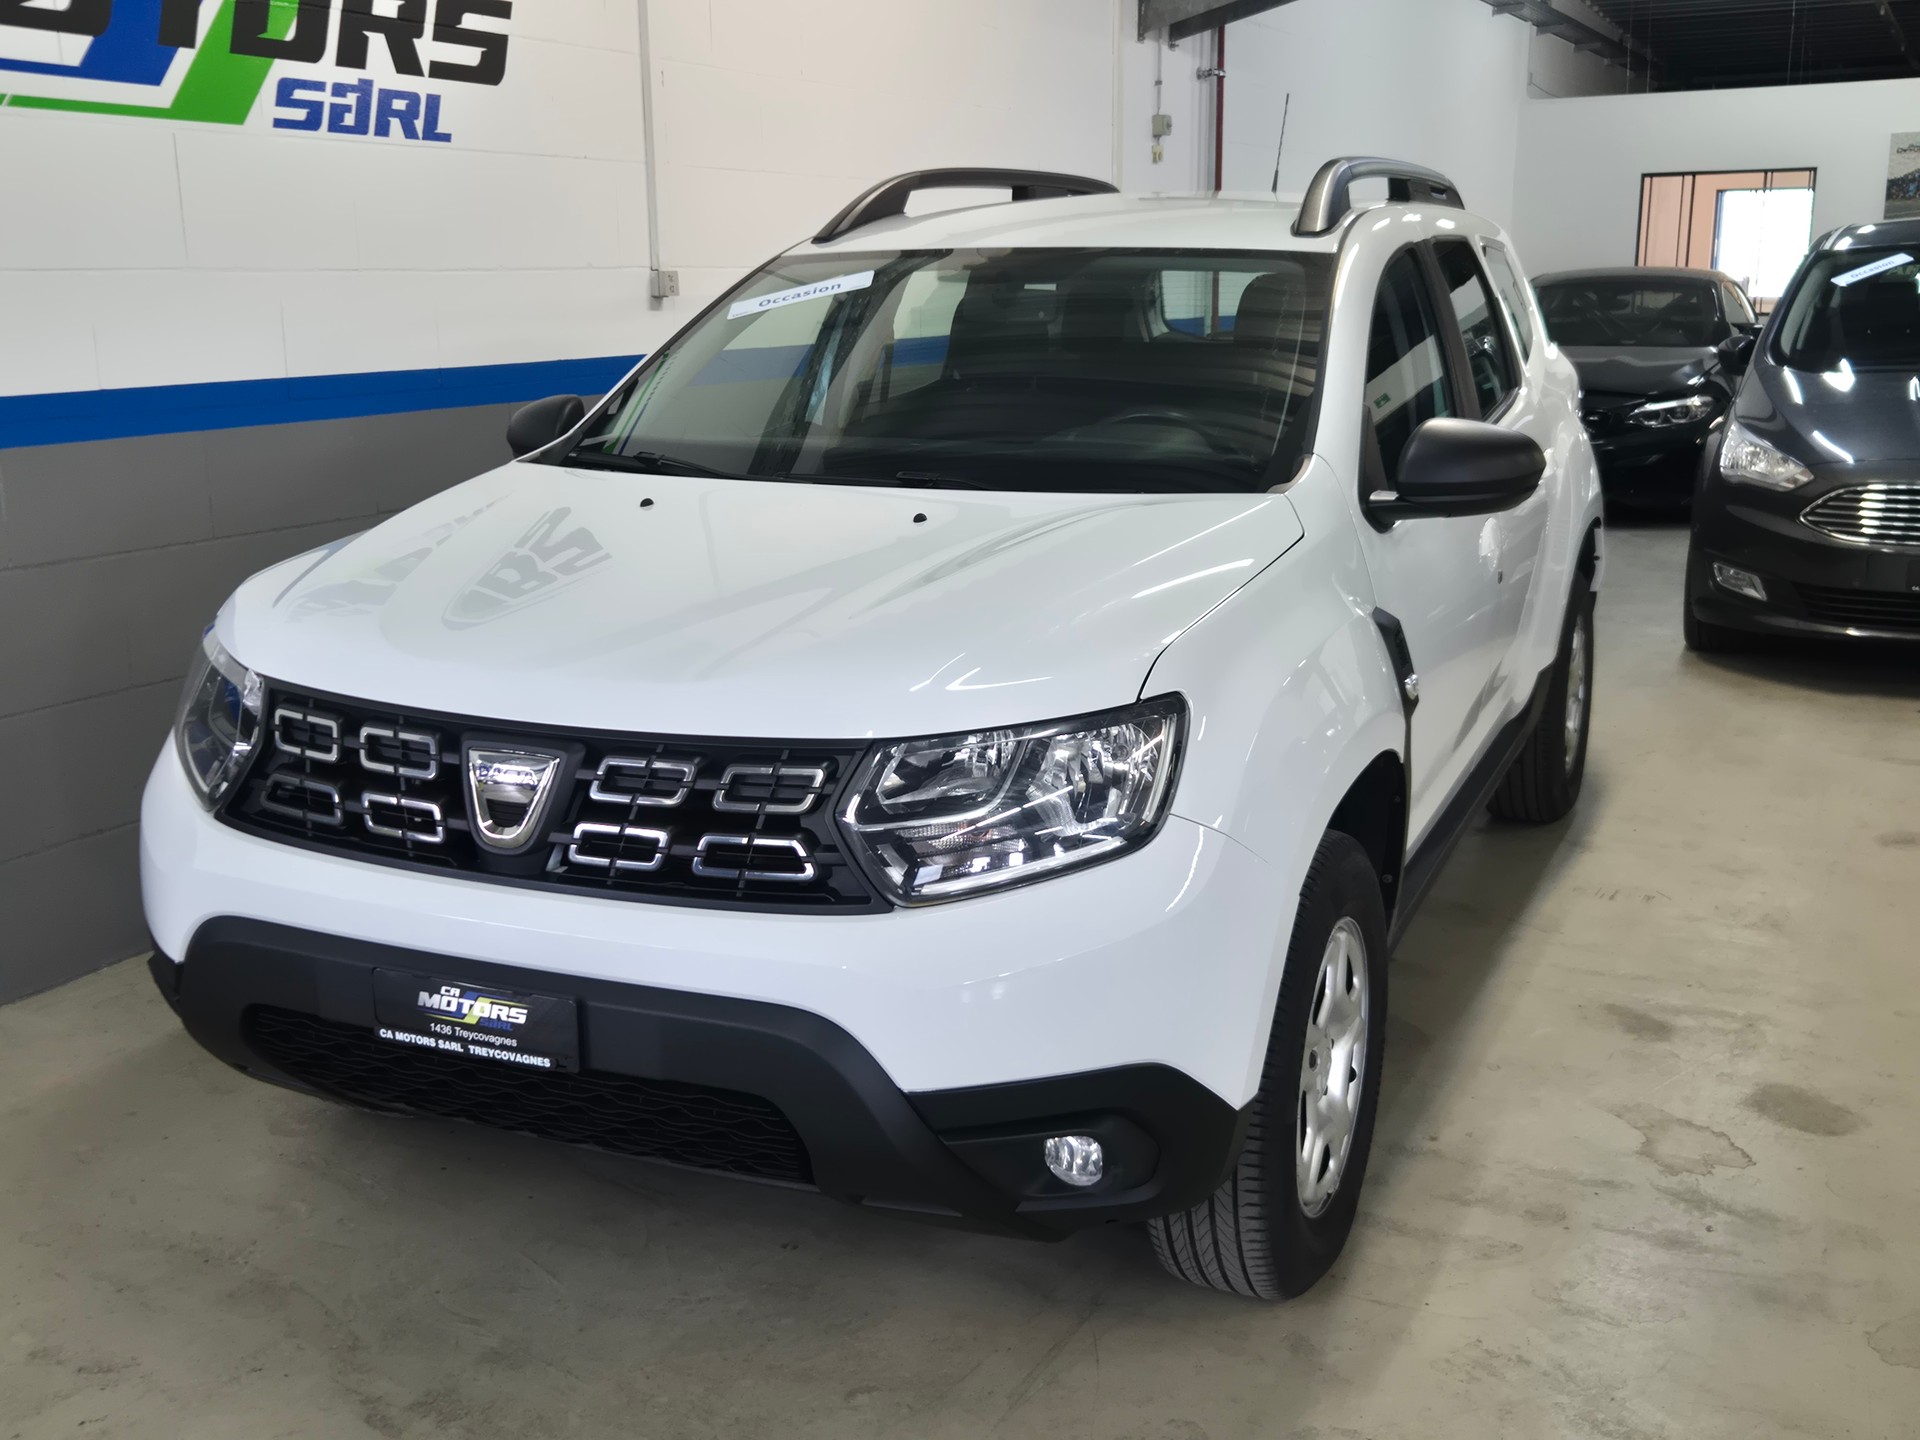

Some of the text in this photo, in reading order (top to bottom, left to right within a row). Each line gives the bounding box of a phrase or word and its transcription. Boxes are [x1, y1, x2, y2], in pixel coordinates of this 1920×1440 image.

[758, 282, 842, 308] Occasion
[440, 985, 461, 997] CA
[417, 991, 528, 1025] MOTORS
[379, 1028, 551, 1067] CA MOTORS SARL TREYCOVAGNES
[430, 1022, 518, 1047] 1436 Treycovagnes
